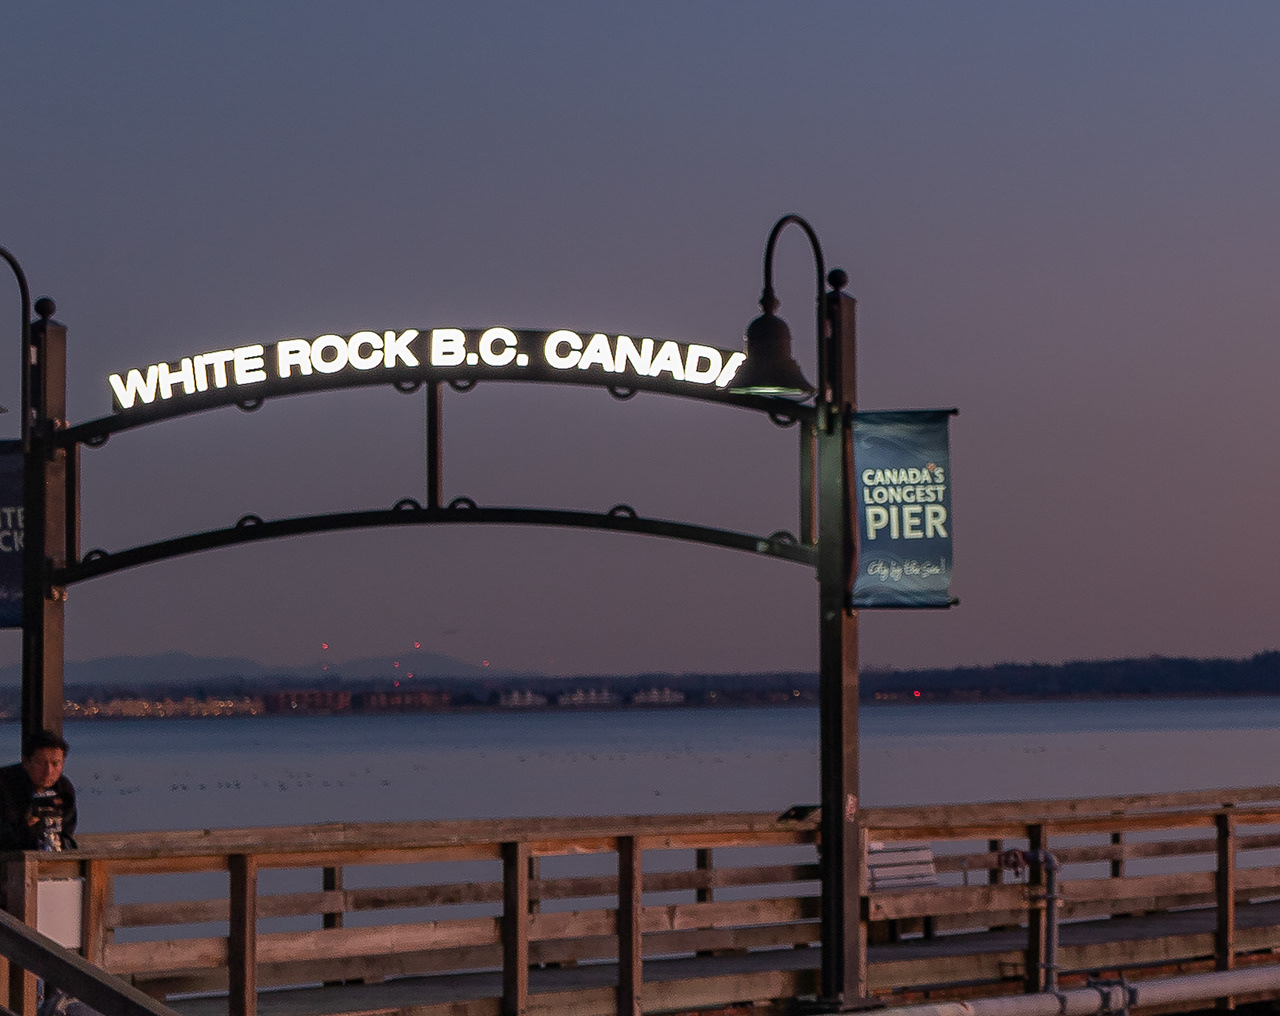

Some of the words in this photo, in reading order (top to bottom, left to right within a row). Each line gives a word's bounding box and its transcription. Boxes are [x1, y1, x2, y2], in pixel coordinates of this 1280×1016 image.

[109, 344, 267, 409] WHITE
[276, 329, 420, 379] ROCK
[431, 327, 529, 367] B.C.
[862, 468, 945, 486] CANADA'S
[863, 485, 946, 505] LONGEST
[865, 504, 949, 541] PIER
